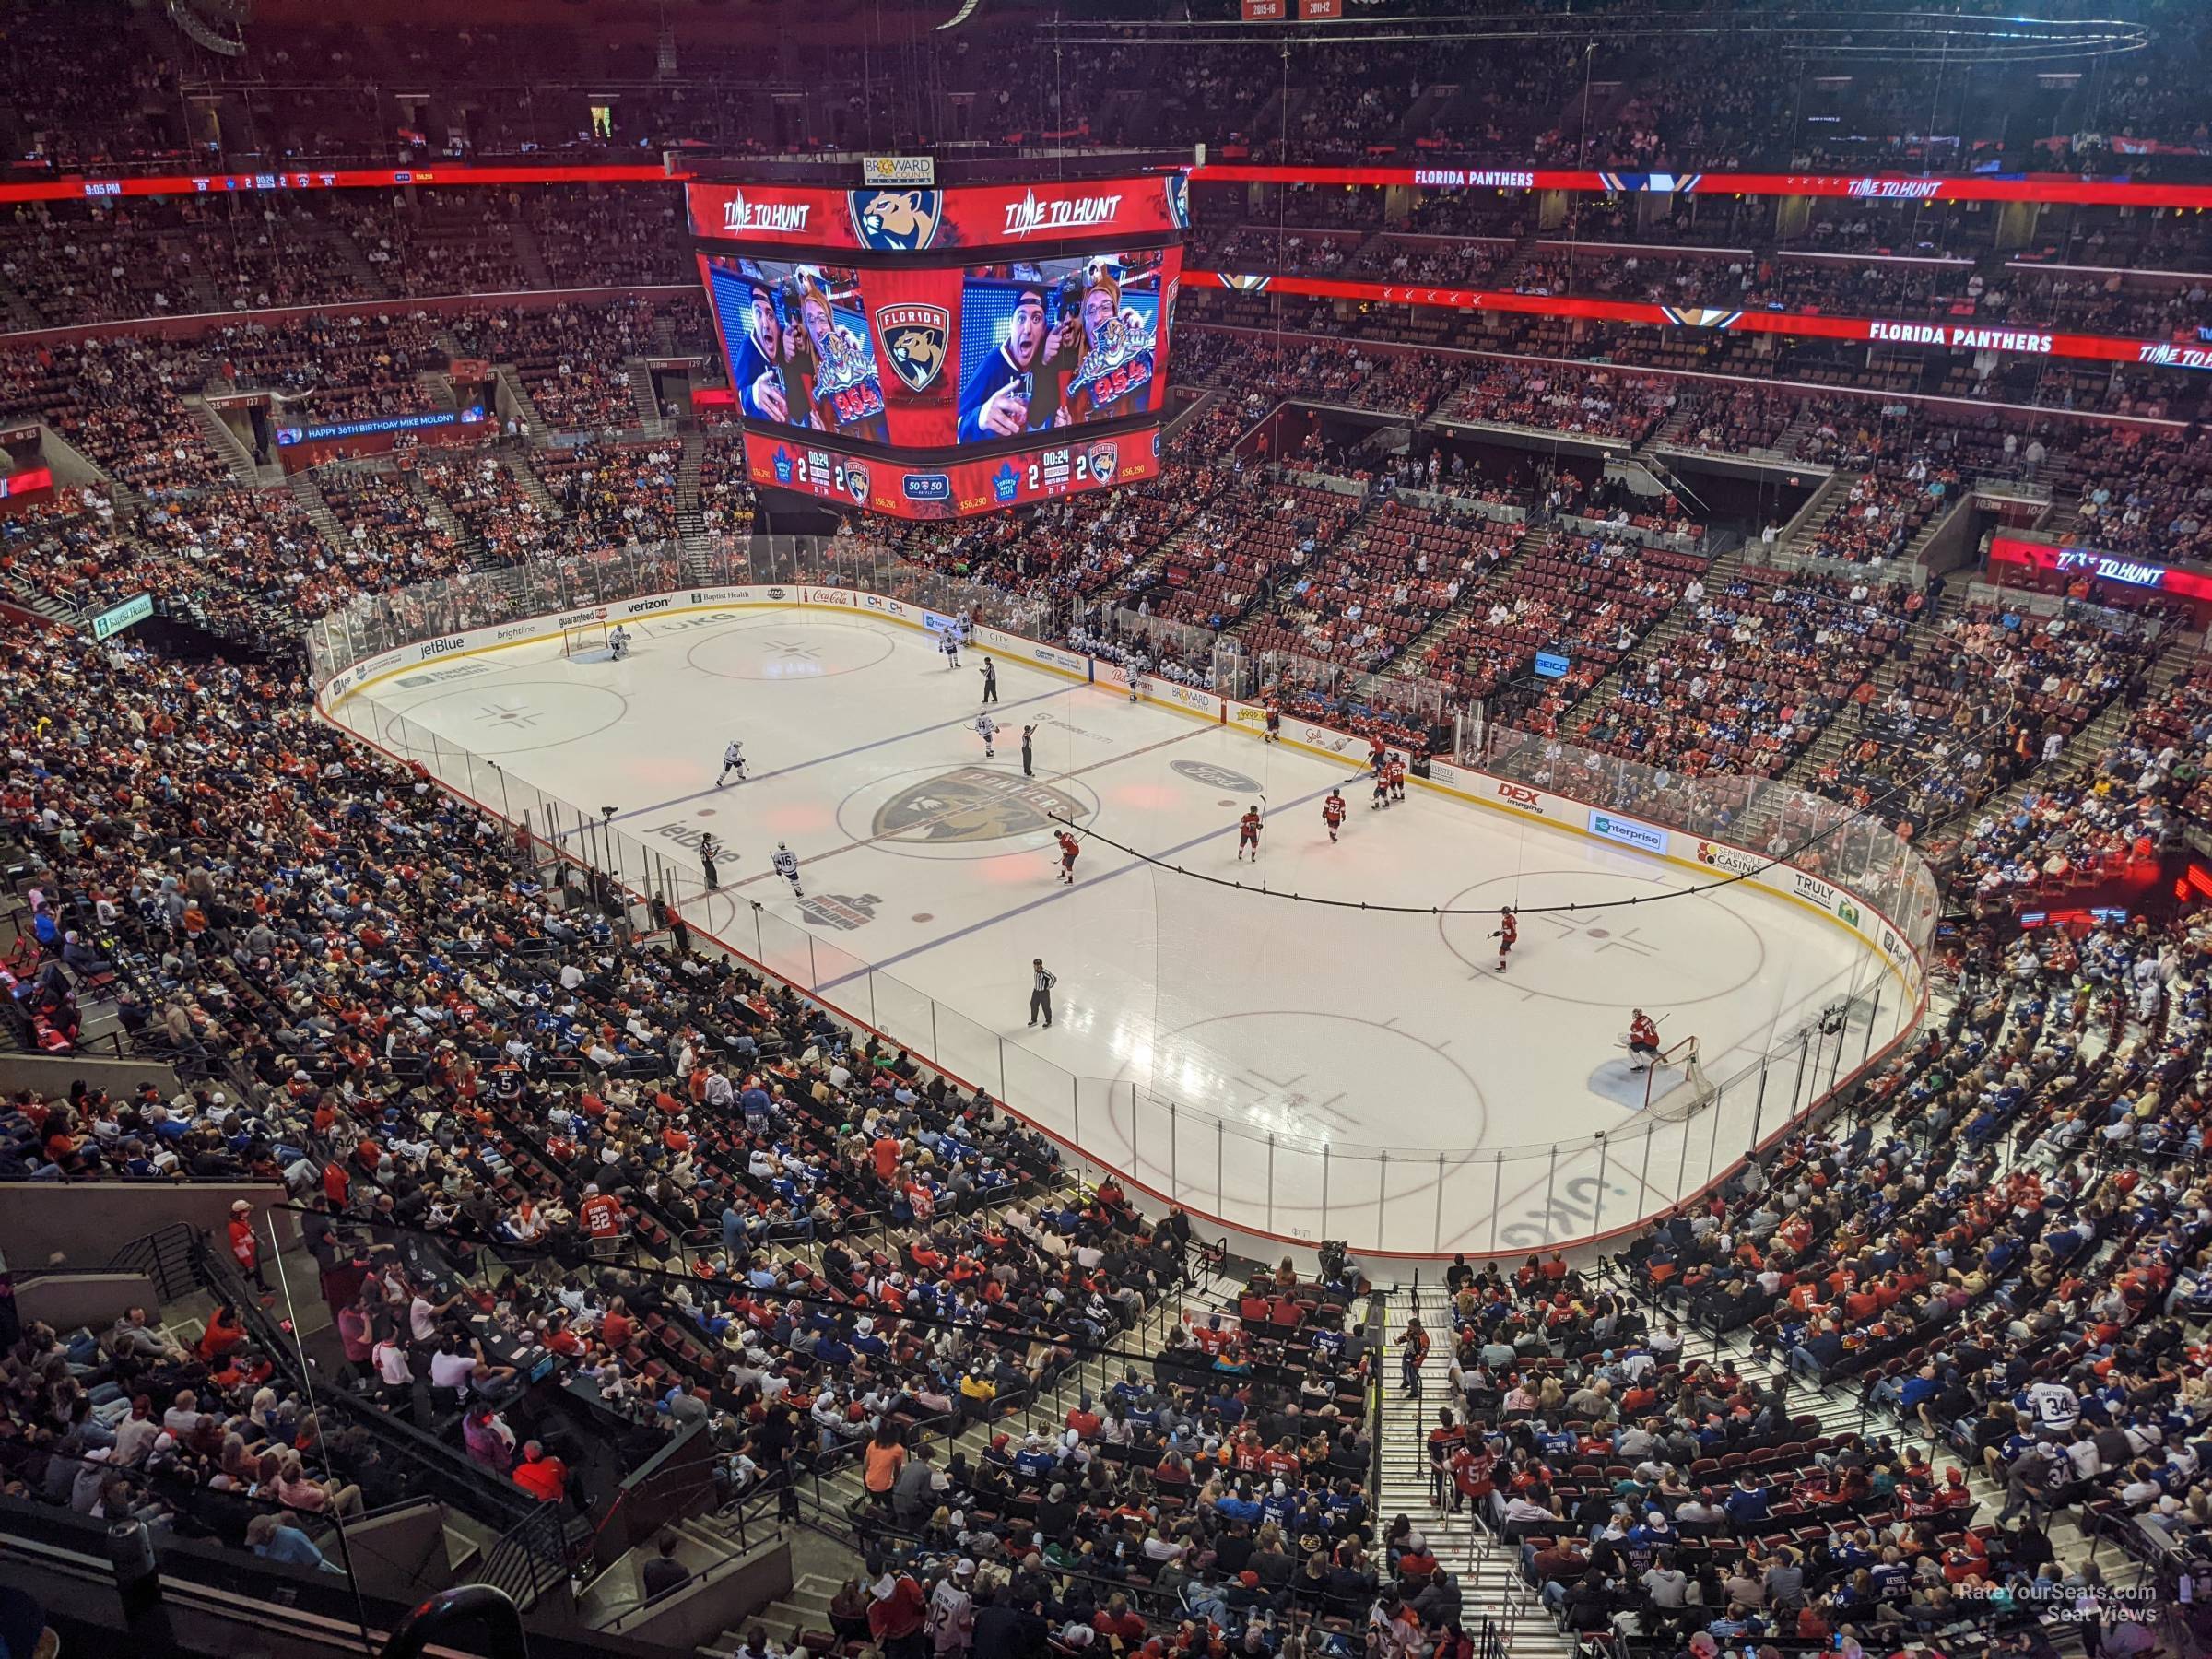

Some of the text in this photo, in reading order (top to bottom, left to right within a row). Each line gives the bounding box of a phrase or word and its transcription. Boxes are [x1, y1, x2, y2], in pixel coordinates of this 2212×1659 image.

[1253, 4, 1276, 15] 2015-16
[1310, 2, 1330, 14] 2011-12
[866, 159, 930, 172] BROWARD
[245, 178, 252, 188] 2
[256, 175, 275, 185] 00:24
[280, 177, 287, 187] 2
[1415, 171, 1534, 186] FLORIDA PANTHERS
[85, 183, 121, 195] 9:05 PM
[1848, 179, 1942, 196] TIME TO HUNT
[724, 194, 810, 231] TIME TO HUNT
[1005, 194, 1123, 234] TIME TO HUNT
[885, 312, 940, 325] FLORIDA
[1869, 323, 2052, 352] FLORIDA PANTHERS
[2138, 345, 2181, 364] TIME
[2182, 350, 2205, 366] TO
[246, 397, 259, 406] 127
[309, 414, 454, 438] HAPPY 36TH BIRTHDAY MIKE MOLONY
[808, 450, 830, 467] 00:24
[1043, 449, 1068, 466] 00:24
[798, 457, 807, 482] 2
[1077, 455, 1087, 481] 2
[1122, 465, 1145, 477] $56,290
[835, 465, 844, 491] 2
[909, 482, 942, 490] 50 50
[1028, 465, 1039, 490] 2
[959, 496, 987, 510] $56,290
[1975, 499, 1992, 509] 103
[2100, 559, 2120, 576] TO
[2120, 562, 2165, 587] HUNT
[703, 590, 749, 602] Baptist Health
[813, 589, 848, 606] Coca-Cola
[109, 599, 150, 629] Baptist Health
[628, 598, 668, 613] verizon
[559, 610, 594, 628] guaranteed
[665, 611, 736, 631] UKG
[498, 624, 535, 639] brightline
[989, 634, 1008, 644] CITY
[420, 636, 465, 660] jetBlue
[1536, 658, 1569, 673] GEICO
[1171, 687, 1209, 706] BROWARD
[1188, 702, 1209, 712] COUNTY
[1189, 766, 1245, 787] Ford
[1391, 767, 1402, 776] 52
[1498, 782, 1541, 806] DEX
[1328, 804, 1340, 814] 62
[1506, 797, 1544, 814] imaging
[1596, 818, 1659, 845] enterprise
[782, 855, 792, 866] 16
[1718, 845, 1762, 866] SEMINOLE
[1716, 863, 1743, 876] COCONUT
[1717, 854, 1761, 875] CASINO
[1795, 872, 1835, 900] TRULY
[501, 1077, 512, 1090] 5
[1499, 1176, 1612, 1249] UKG
[591, 1212, 611, 1231] 22
[1802, 1294, 1813, 1307] 16
[2045, 1398, 2068, 1417] 34
[1468, 1464, 1489, 1484] 52
[1265, 1506, 1285, 1518] TAVARES
[1886, 1575, 1906, 1584] KESSEL
